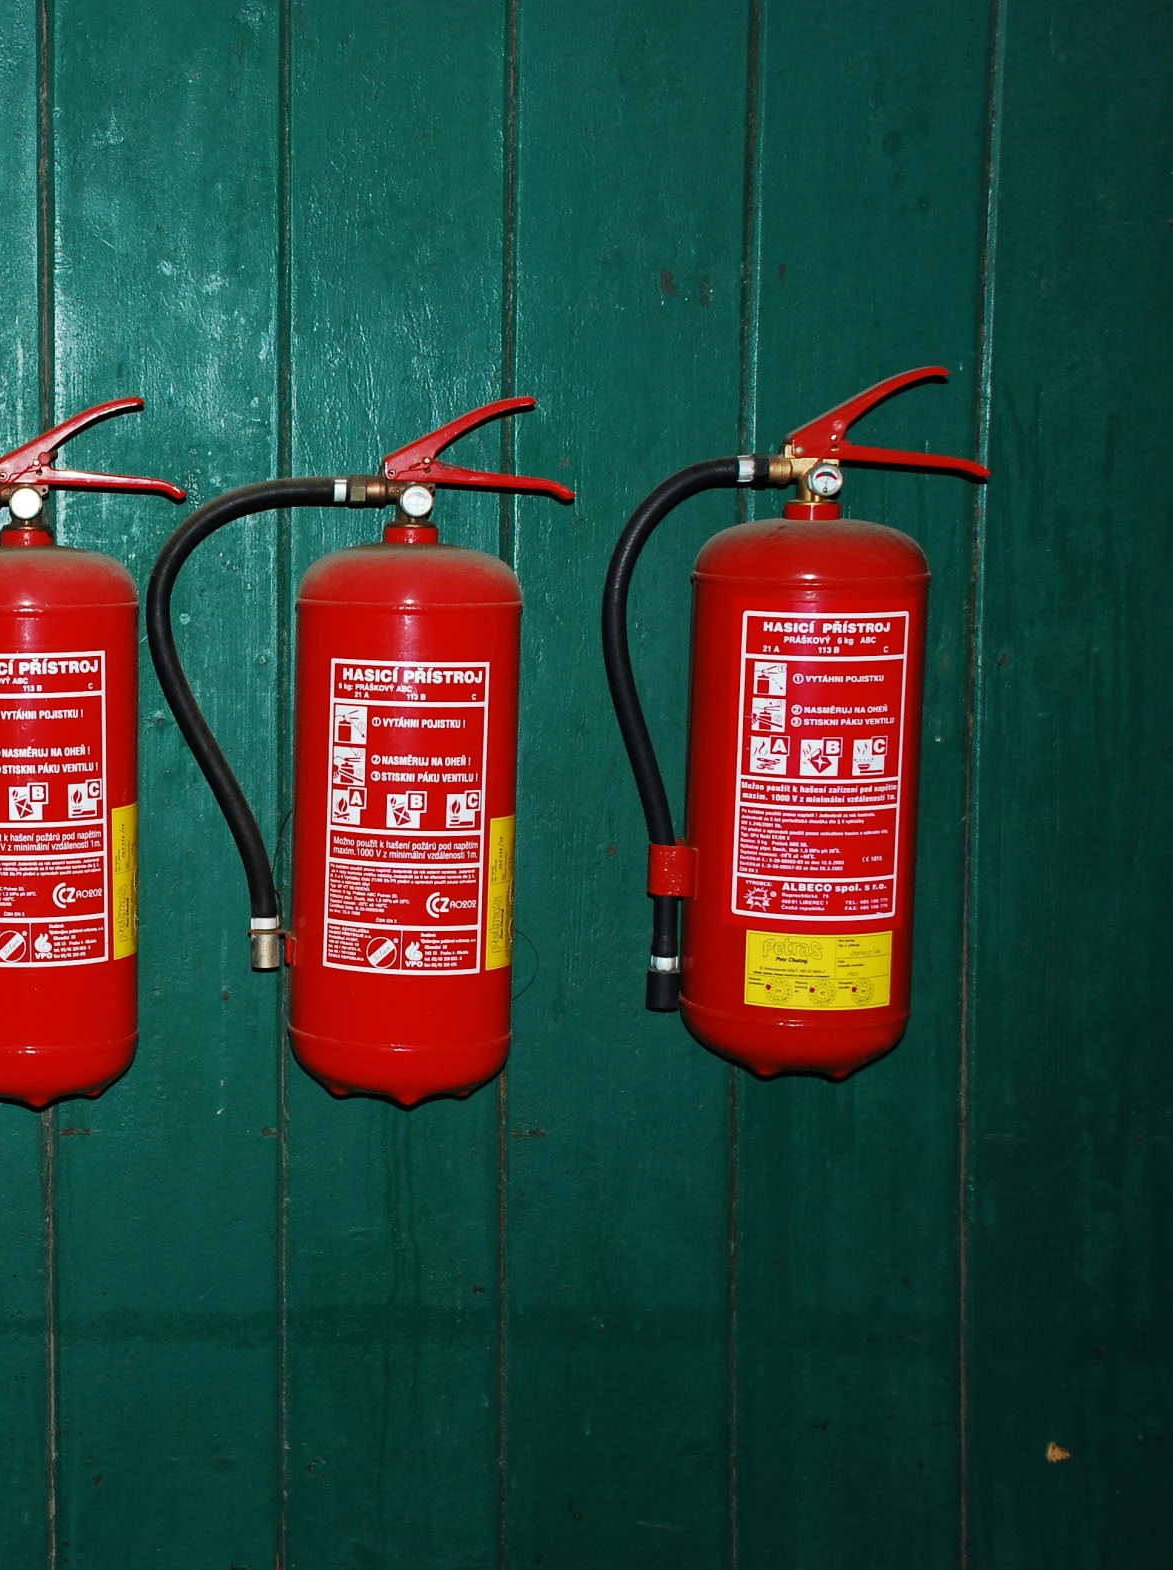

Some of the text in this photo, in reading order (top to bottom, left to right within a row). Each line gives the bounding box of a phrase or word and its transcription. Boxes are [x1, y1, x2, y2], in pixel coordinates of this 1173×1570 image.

[763, 621, 891, 633] HASICÍ PŘÍSTROJ
[784, 636, 830, 644] PRÁŠKOVÝ
[844, 637, 854, 645] kg
[19, 659, 98, 675] PŘÍSTROJ
[343, 668, 483, 684] HASICÍ PŘÍSTROJ
[805, 675, 843, 683] VYTÁHNI
[355, 683, 394, 692] PRÁŠKOVÝ
[1, 709, 78, 720] VYTÁHNI POJISTKU
[803, 705, 852, 714] NASMĚRUJ
[867, 704, 887, 712] OHEŇ
[383, 717, 460, 728] VYTÁHNI POJISTKU
[2, 745, 85, 758] NASMĚRUJ NA OHEŇ
[772, 740, 886, 754] A B C
[382, 755, 466, 766] NASMĚRUJ NA OHEŇ
[2, 763, 94, 774] STISKNI PÁKU VENTILU
[382, 772, 473, 782] STISKNI PÁKU VENTILU
[32, 786, 44, 800] B
[89, 782, 100, 796] C
[742, 782, 764, 790] Možno
[766, 784, 790, 792] použít
[860, 785, 872, 794] pod
[874, 784, 897, 793] napětím
[350, 791, 478, 808] A B C
[742, 792, 768, 800] maxim.
[782, 883, 832, 892] ALBECO
[835, 884, 862, 893] spol.
